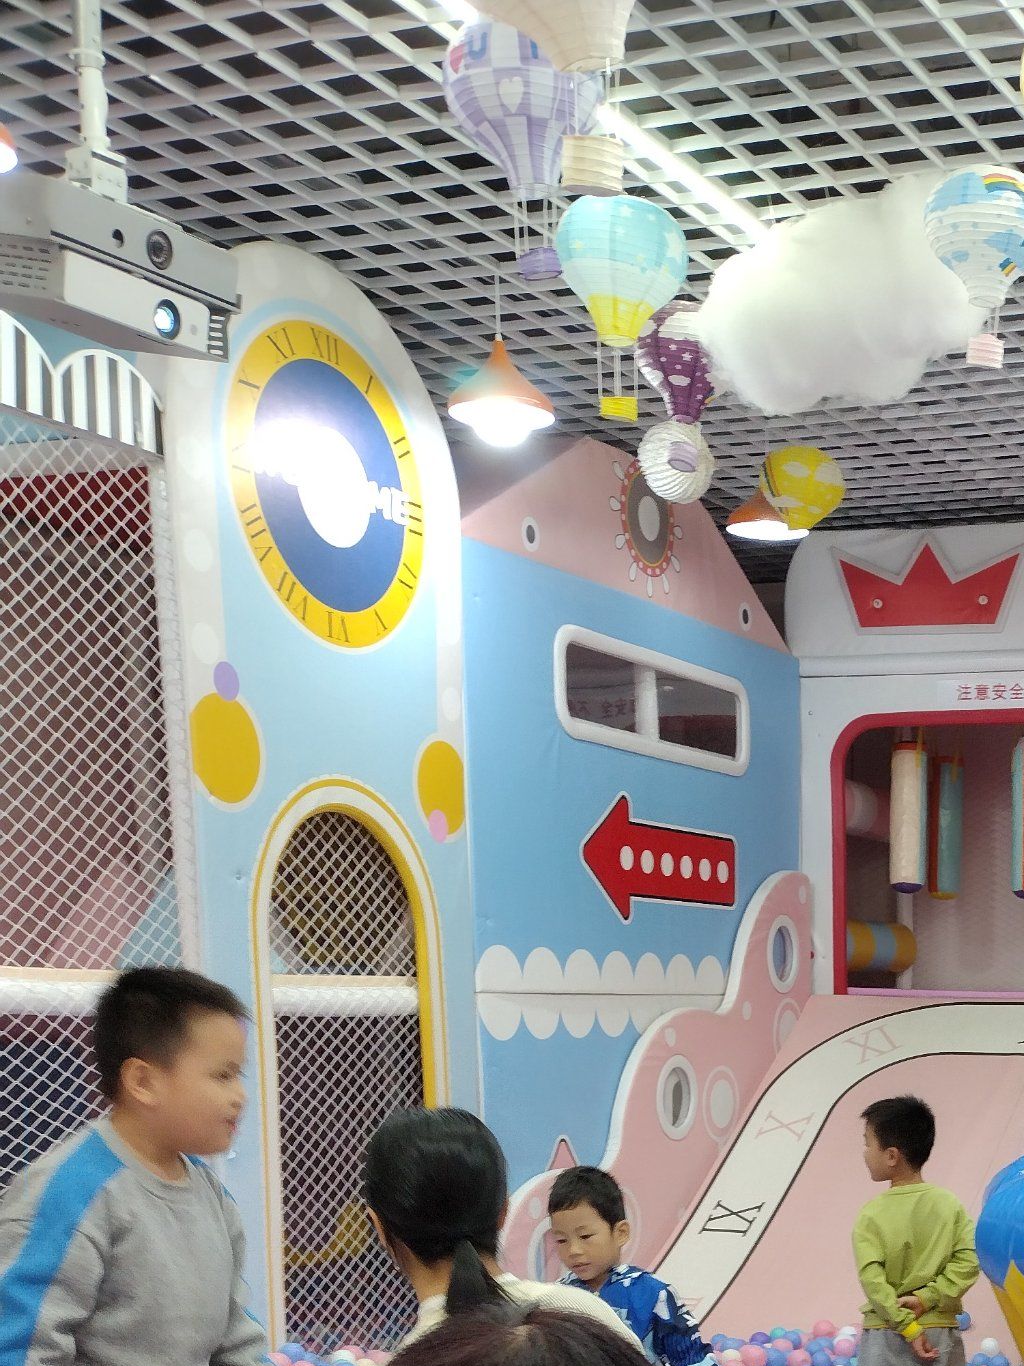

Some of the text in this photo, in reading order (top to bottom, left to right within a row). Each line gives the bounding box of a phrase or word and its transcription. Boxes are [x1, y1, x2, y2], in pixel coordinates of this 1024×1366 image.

[310, 326, 341, 366] XII
[956, 683, 1024, 701] 注意安全
[842, 1024, 904, 1065] XI
[754, 1110, 816, 1142] X
[697, 1200, 766, 1238] IX
